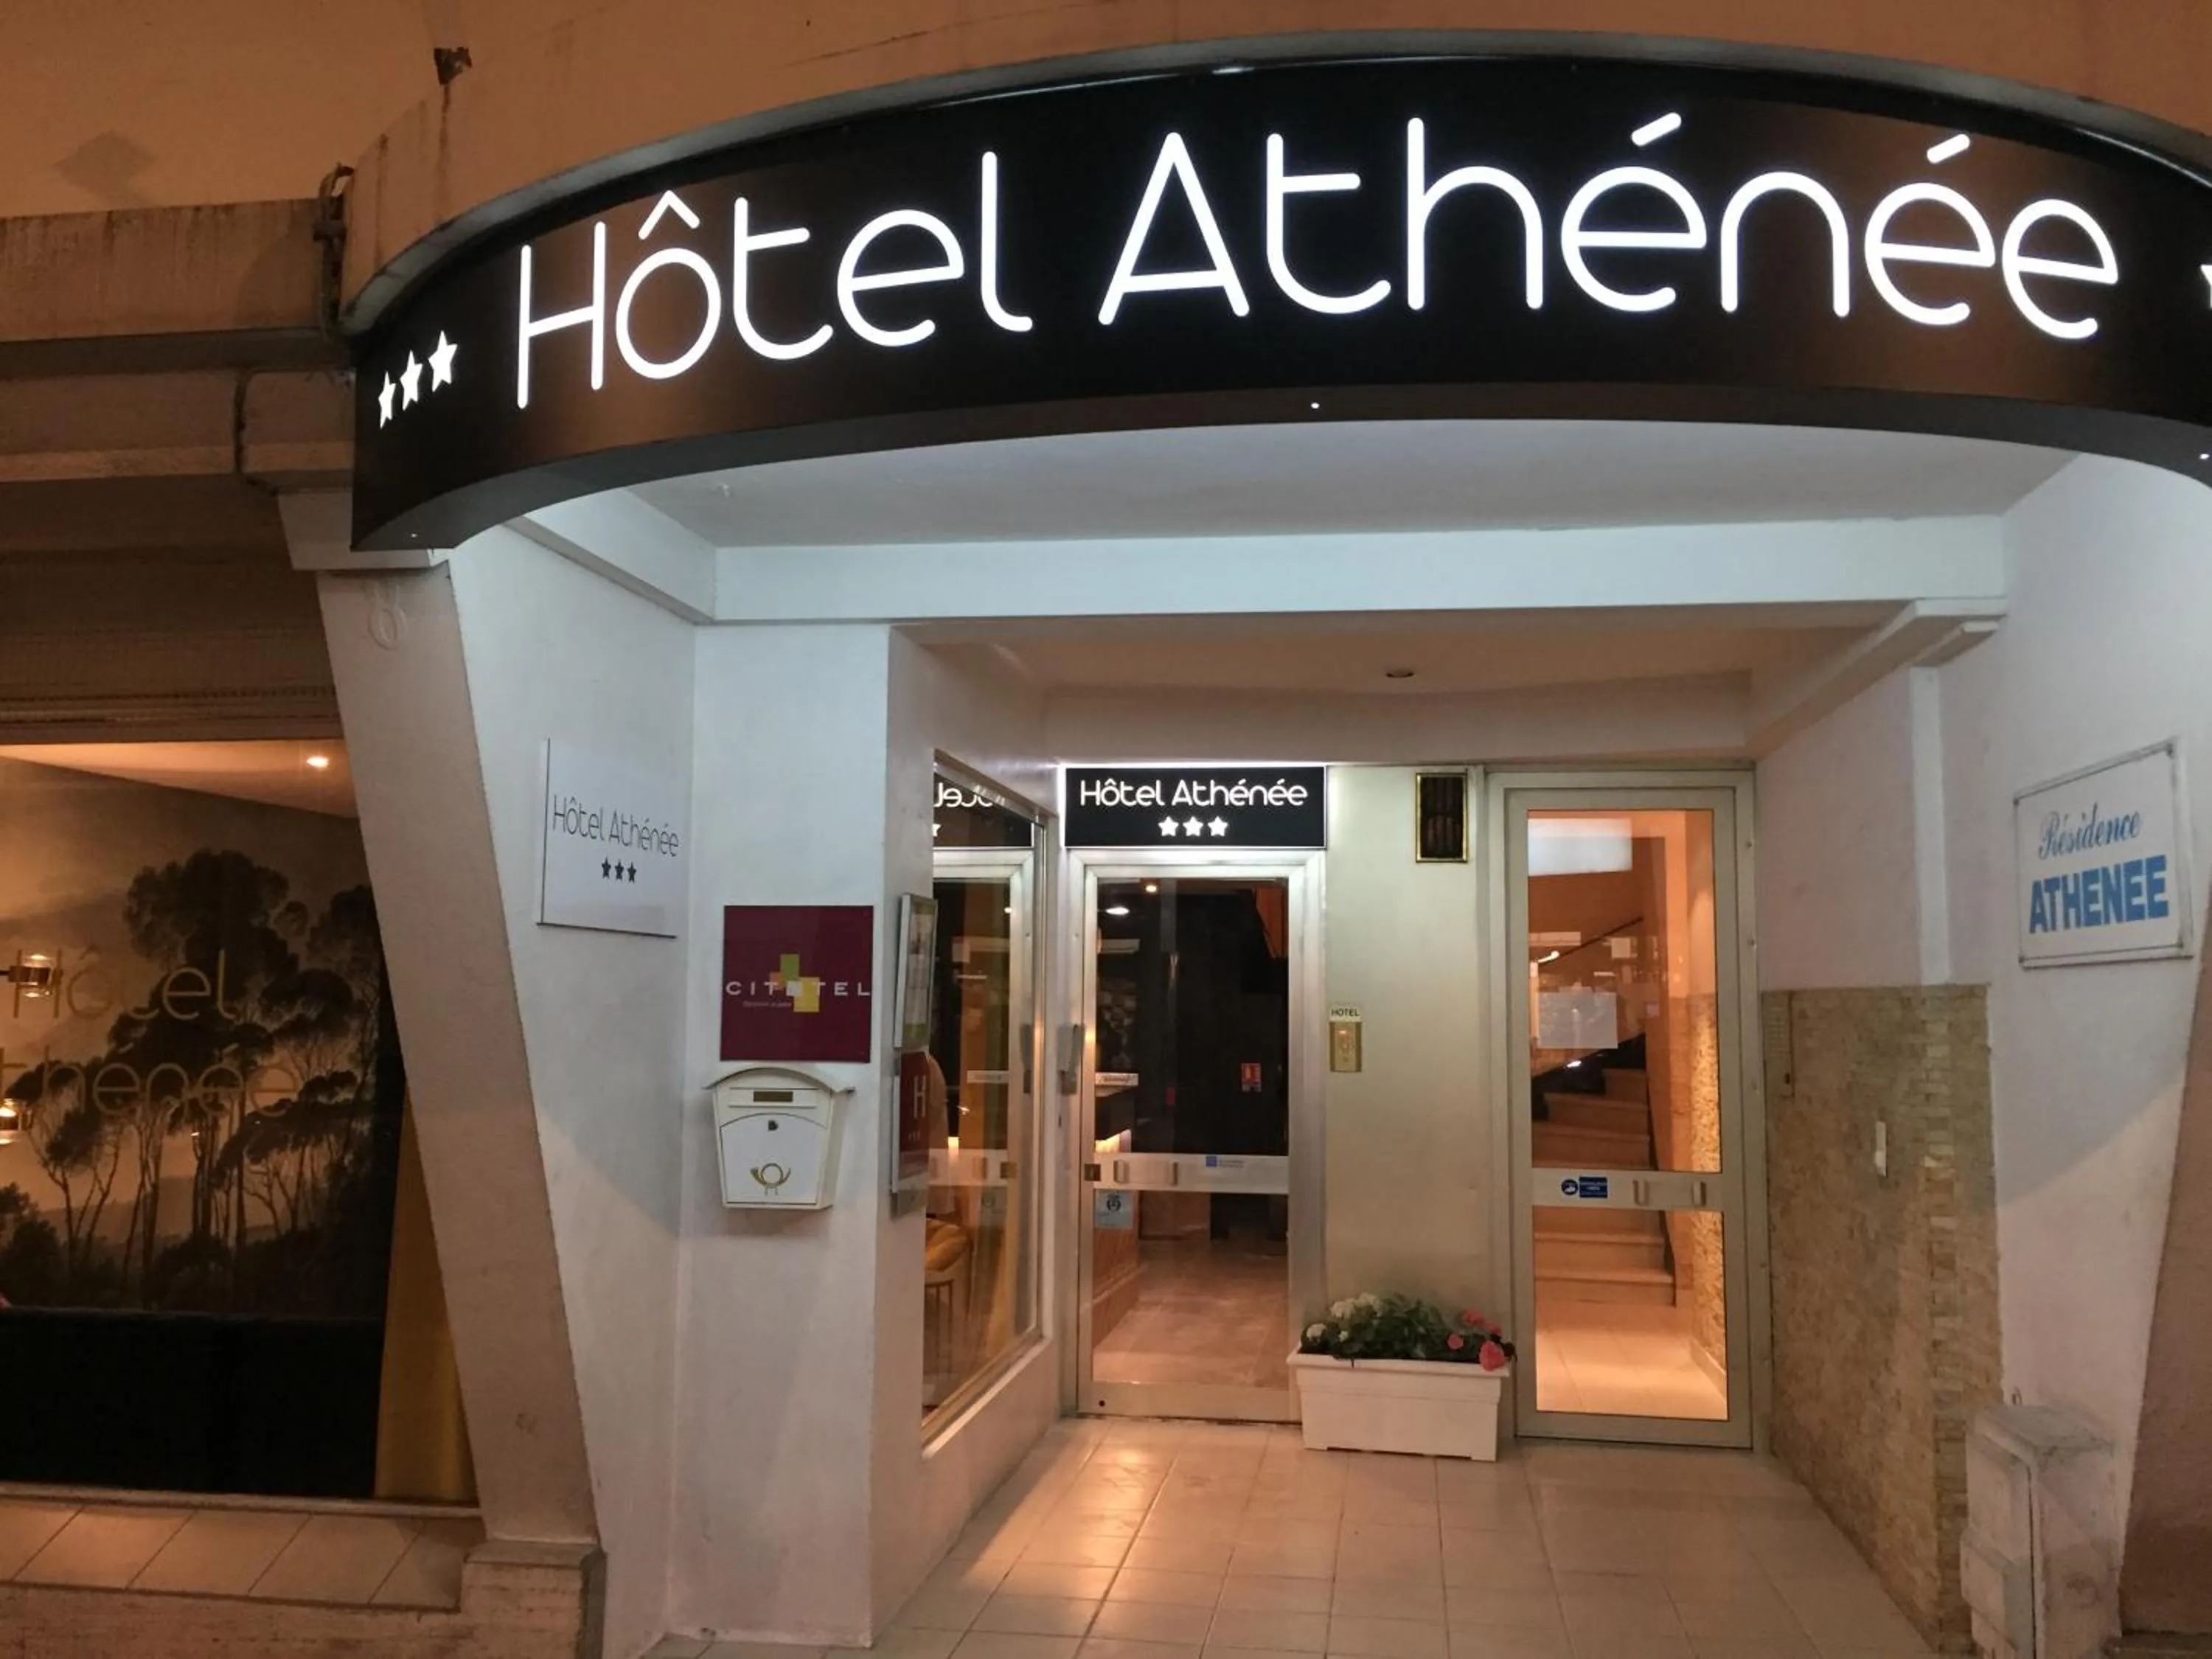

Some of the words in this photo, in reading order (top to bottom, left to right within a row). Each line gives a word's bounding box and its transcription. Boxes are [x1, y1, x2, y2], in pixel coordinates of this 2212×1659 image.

[517, 150, 1034, 409] Hôtel
[1097, 112, 2119, 340] Athénée
[1079, 778, 1166, 807] Hôtel
[1171, 778, 1309, 807] Athénée
[552, 794, 605, 841] Hôtel
[608, 810, 680, 858] Athénée
[2037, 801, 2143, 860] Résidence
[2029, 854, 2170, 935] ATHENEE
[1331, 1007, 1360, 1017] HOTEL
[0, 1042, 300, 1118] thénée
